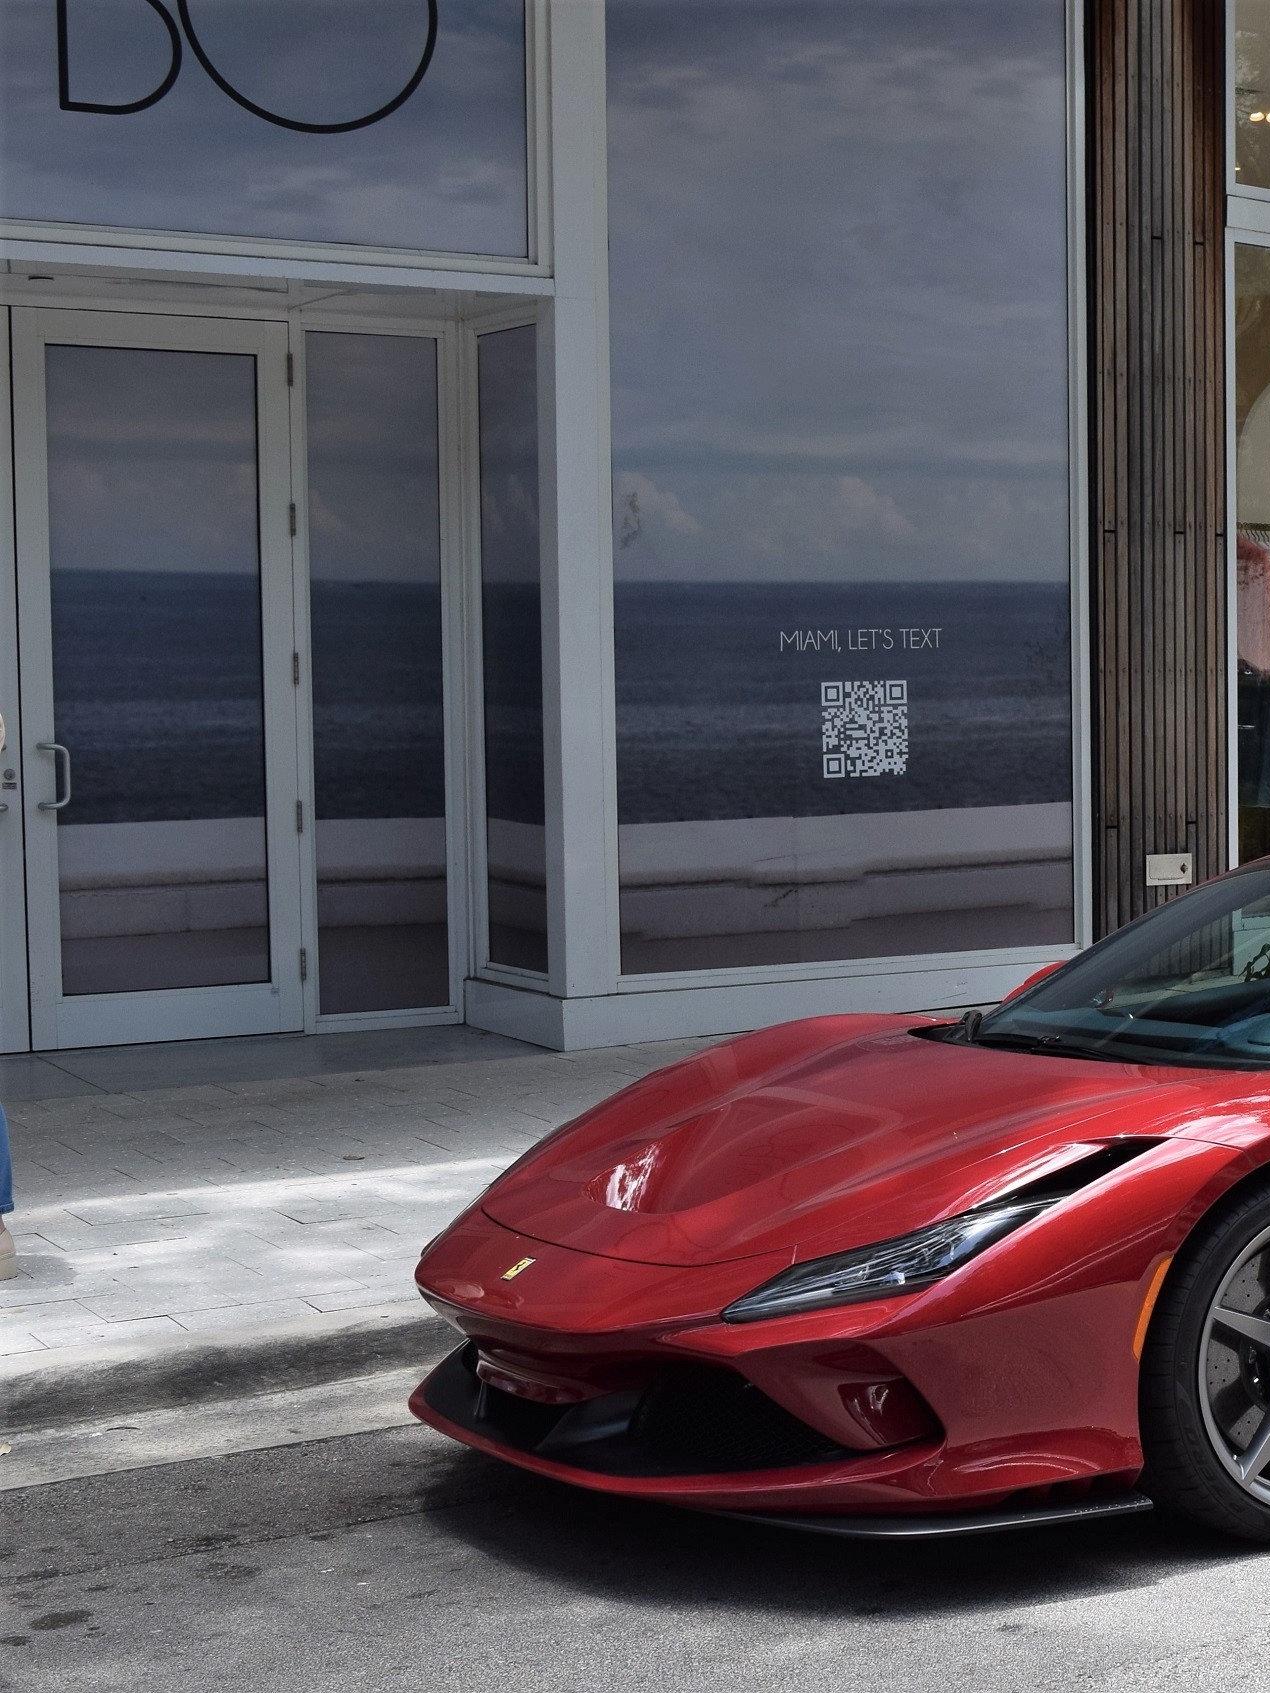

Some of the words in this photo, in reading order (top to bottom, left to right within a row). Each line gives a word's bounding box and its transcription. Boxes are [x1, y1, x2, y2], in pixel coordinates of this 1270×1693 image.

[780, 630, 842, 653] MIAMI,
[848, 629, 894, 650] LET'S
[899, 628, 942, 649] TEXT
